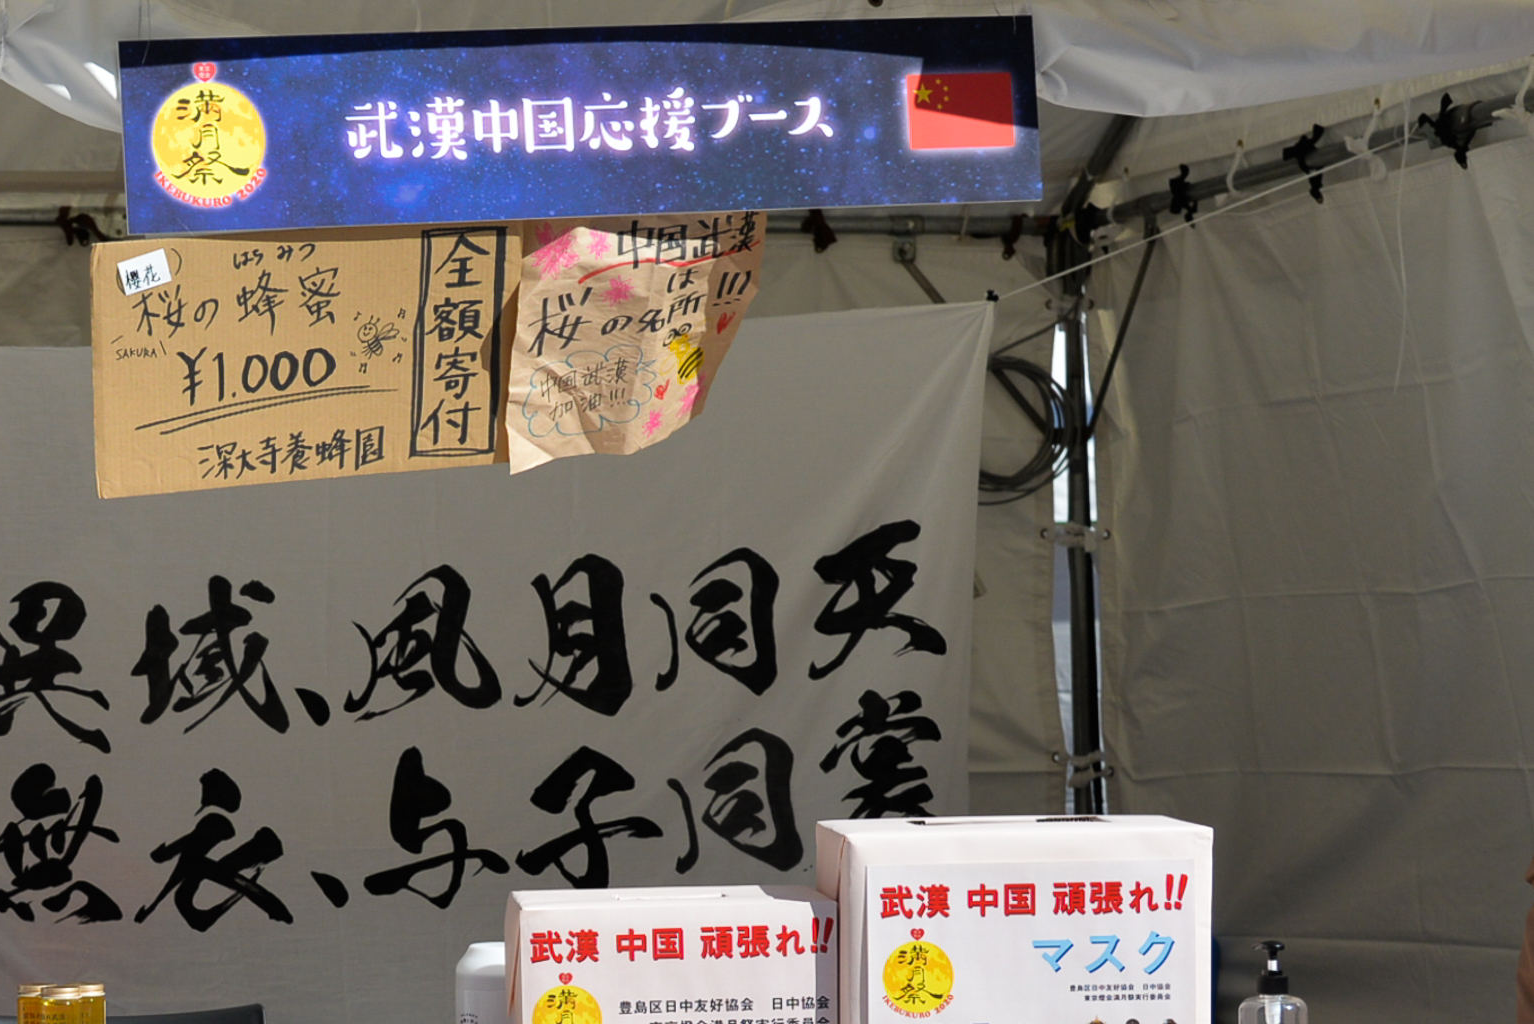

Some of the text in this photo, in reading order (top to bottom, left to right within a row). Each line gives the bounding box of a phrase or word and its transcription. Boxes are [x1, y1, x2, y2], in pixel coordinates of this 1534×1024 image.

[171, 89, 250, 186] 満月祭
[344, 86, 834, 161] 武漢中国応援ブース
[153, 168, 268, 208] IKEBUKURO 2020
[616, 211, 758, 269] 中国武漢
[131, 266, 341, 338] 桜の蜂蜜
[115, 347, 158, 361] SAKURA
[421, 233, 490, 446] 全額寄付
[540, 357, 630, 404] 中国武漢
[196, 425, 385, 480] 深大寺養蜂園
[879, 884, 951, 919] 武漢
[967, 883, 1036, 917] 中国
[529, 929, 600, 964] 武漢
[615, 926, 685, 961] 中国
[1031, 930, 1175, 975] マスク
[892, 944, 945, 1005] 満月祭
[619, 995, 831, 1016] 豊島区日中友好協会 日中協会
[881, 994, 955, 1019] IKEBUKURO 2020
